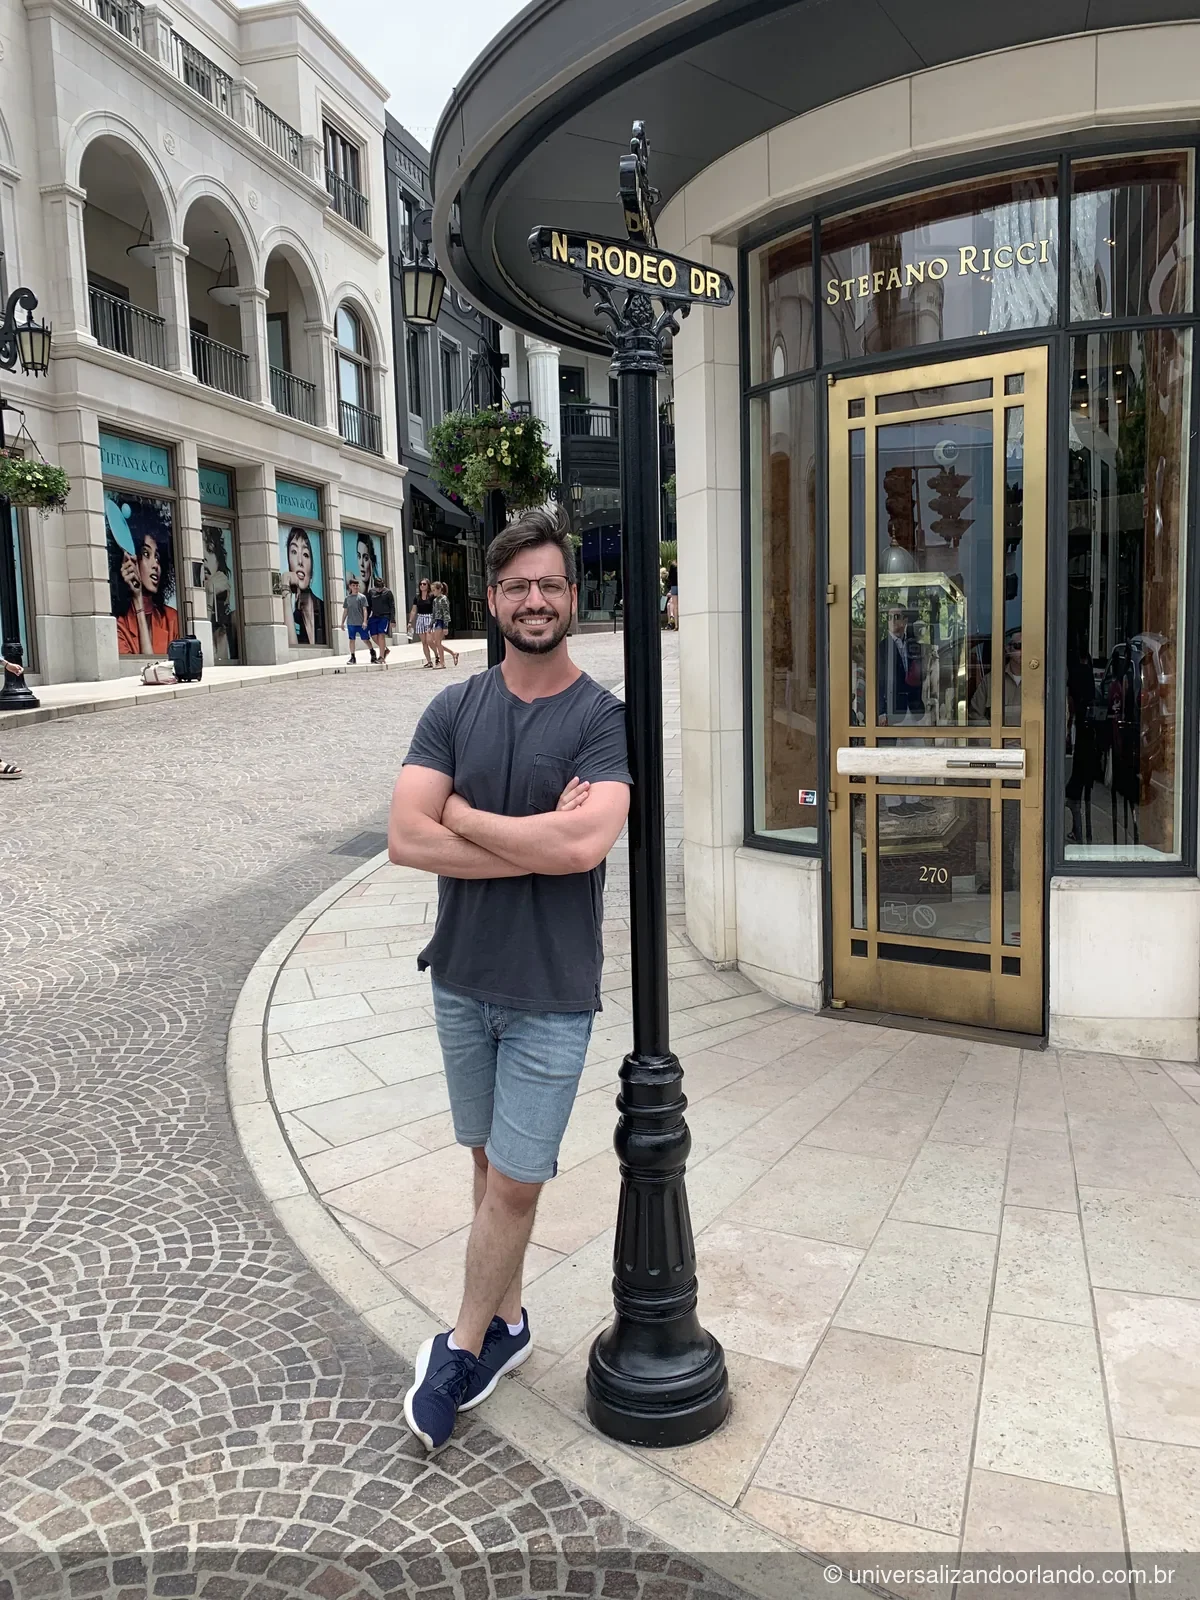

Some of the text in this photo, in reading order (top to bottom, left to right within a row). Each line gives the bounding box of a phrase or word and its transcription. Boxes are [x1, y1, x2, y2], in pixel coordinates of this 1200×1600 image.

[551, 231, 721, 299] N. RODEO DR
[826, 239, 1050, 306] STEFANO RICCI
[919, 866, 948, 884] 270
